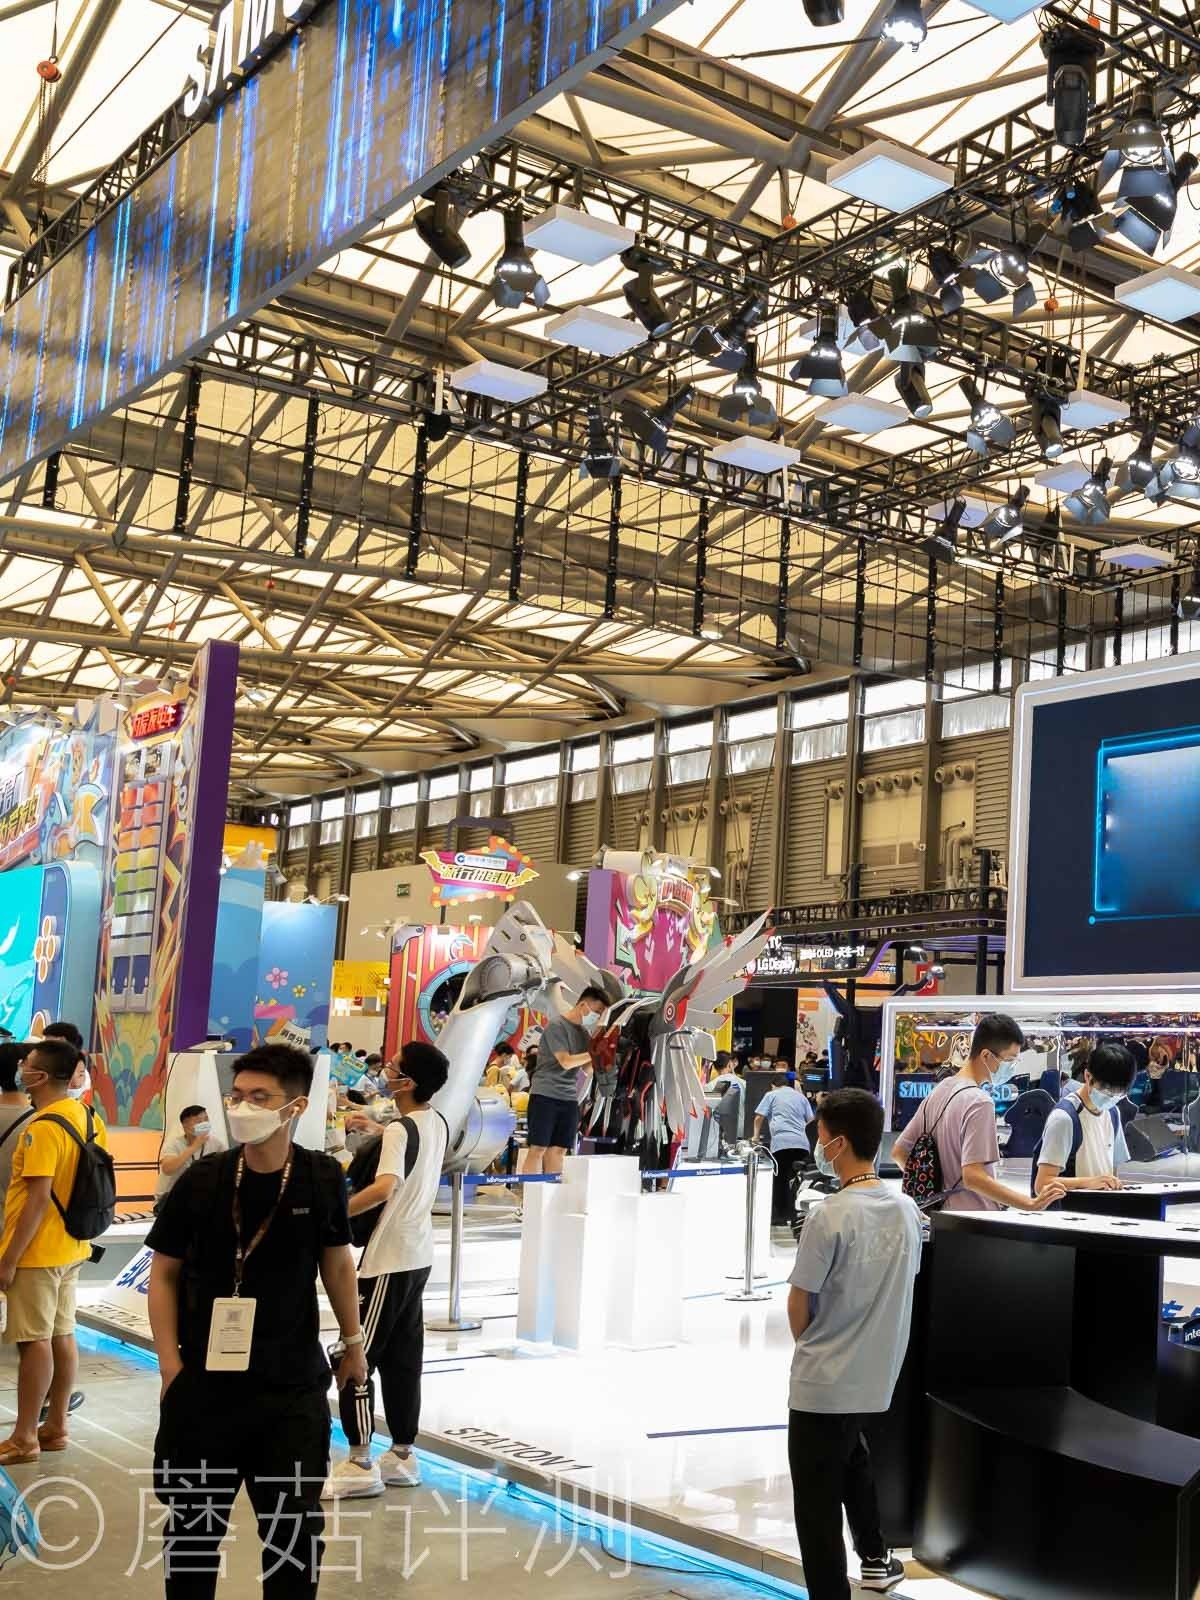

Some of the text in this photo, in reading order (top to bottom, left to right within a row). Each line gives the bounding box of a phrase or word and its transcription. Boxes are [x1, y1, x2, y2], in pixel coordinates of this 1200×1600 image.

[184, 0, 301, 117] SAM
[757, 958, 768, 971] LG
[444, 1427, 574, 1467] STATION
